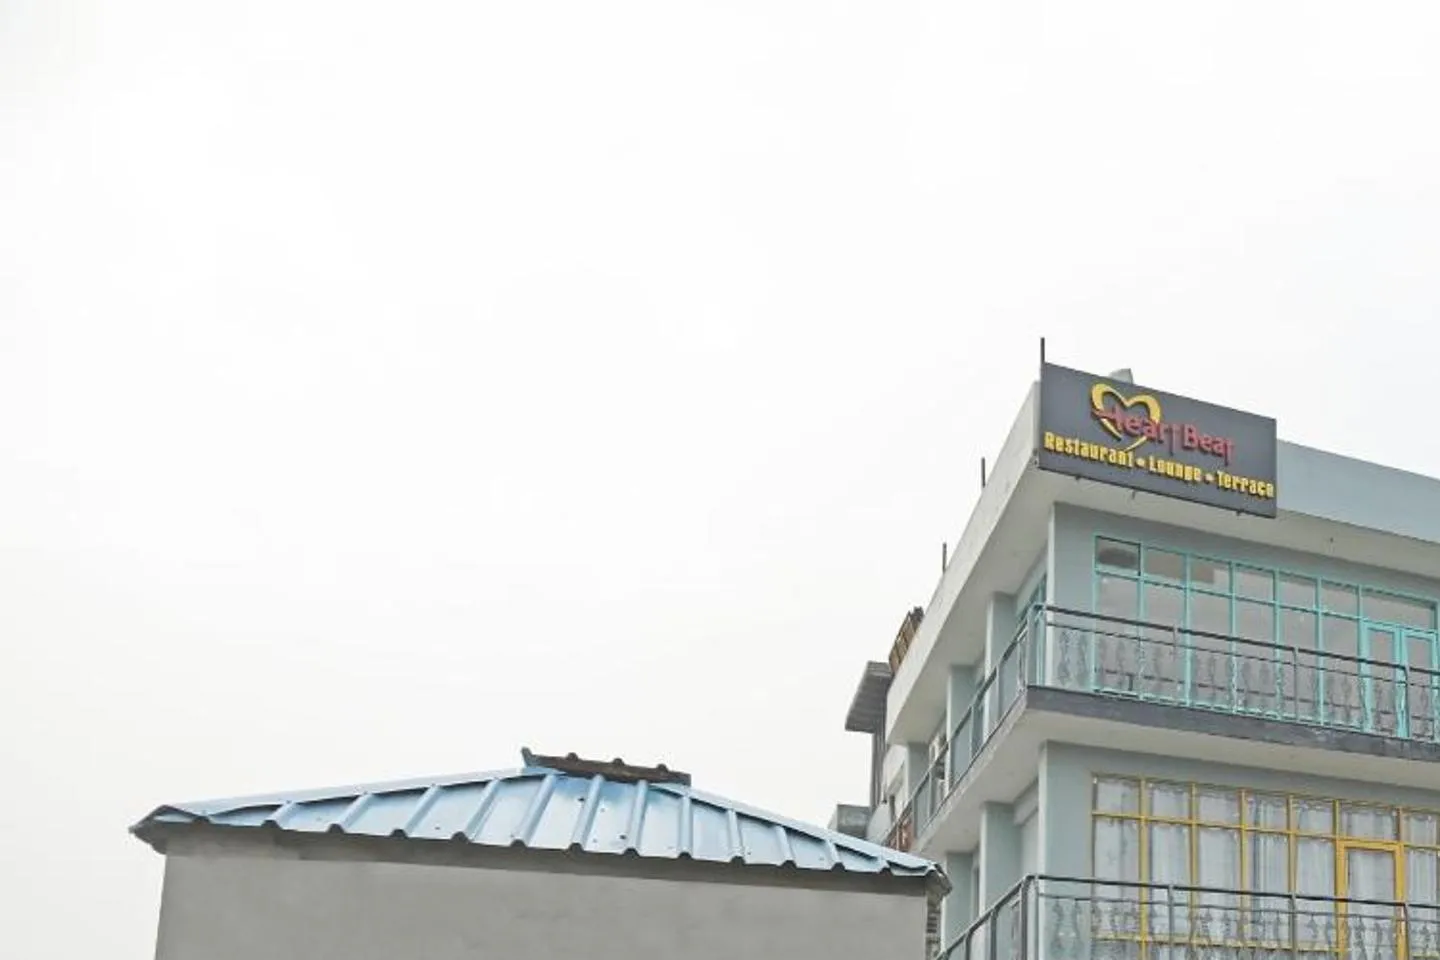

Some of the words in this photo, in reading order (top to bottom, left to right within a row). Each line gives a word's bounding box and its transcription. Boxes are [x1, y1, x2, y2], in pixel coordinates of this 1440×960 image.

[1043, 432, 1135, 468] Restaurant
[1149, 456, 1203, 482] Lounge
[1216, 470, 1275, 498] Terrace
[1183, 423, 1236, 464] Beat
